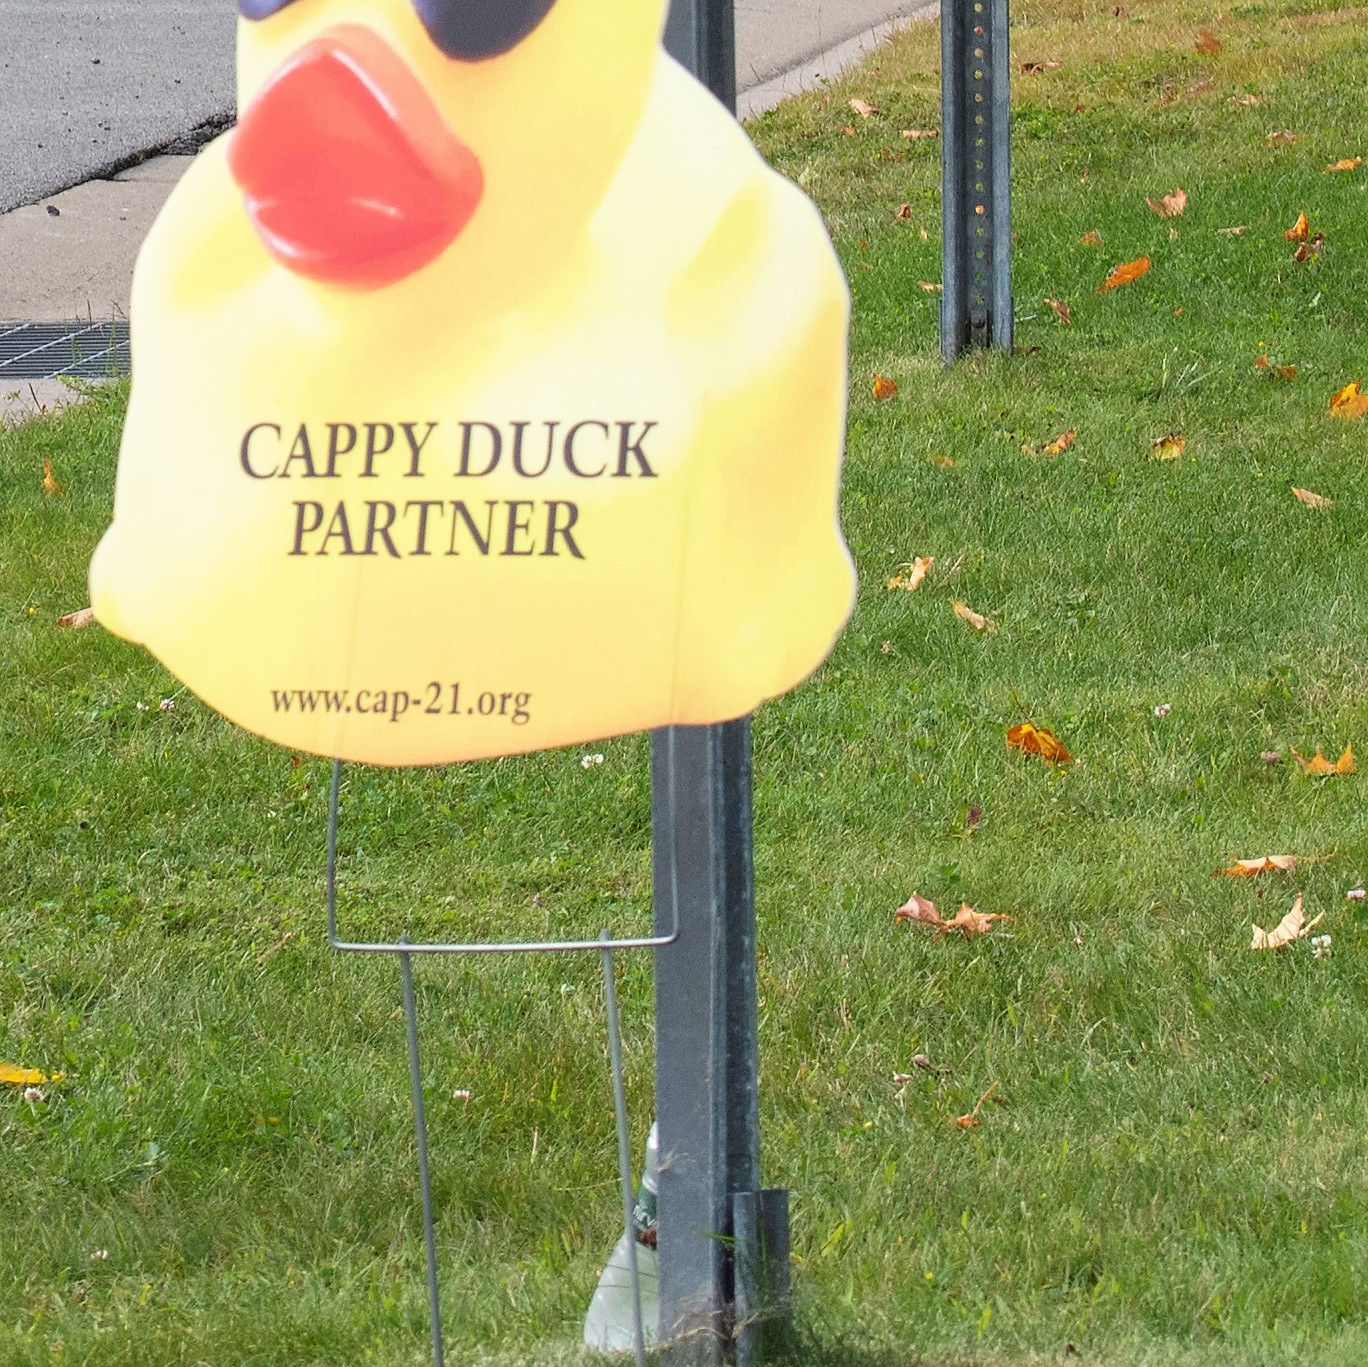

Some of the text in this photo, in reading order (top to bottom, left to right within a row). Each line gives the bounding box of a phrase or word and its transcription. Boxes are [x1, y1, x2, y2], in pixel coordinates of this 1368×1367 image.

[239, 420, 659, 480] CAPPY DUCK
[287, 499, 587, 560] PARTNER
[270, 680, 532, 726] www.cap-21.org
